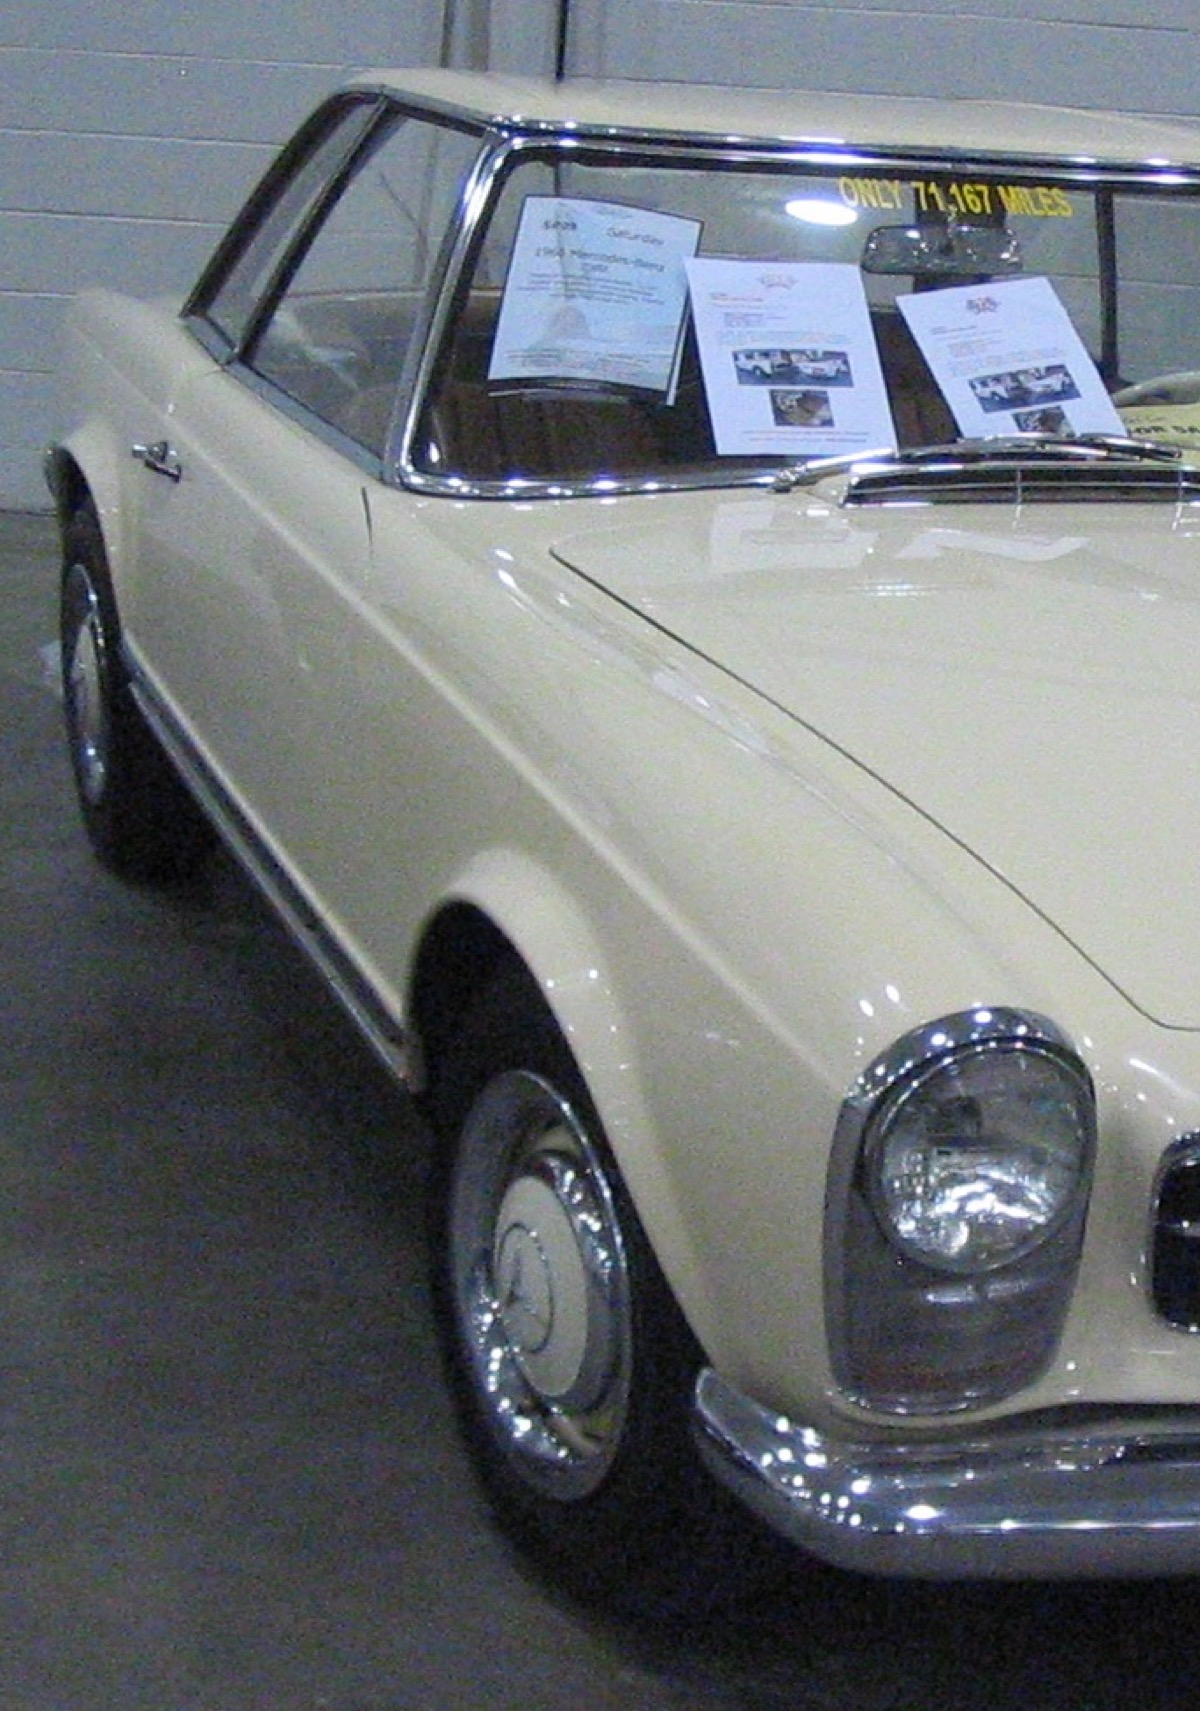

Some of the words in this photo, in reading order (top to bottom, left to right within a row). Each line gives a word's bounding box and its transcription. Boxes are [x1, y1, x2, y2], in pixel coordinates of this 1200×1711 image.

[839, 177, 902, 209] ONLY
[911, 181, 992, 214] 71,167
[997, 185, 1074, 217] MILES
